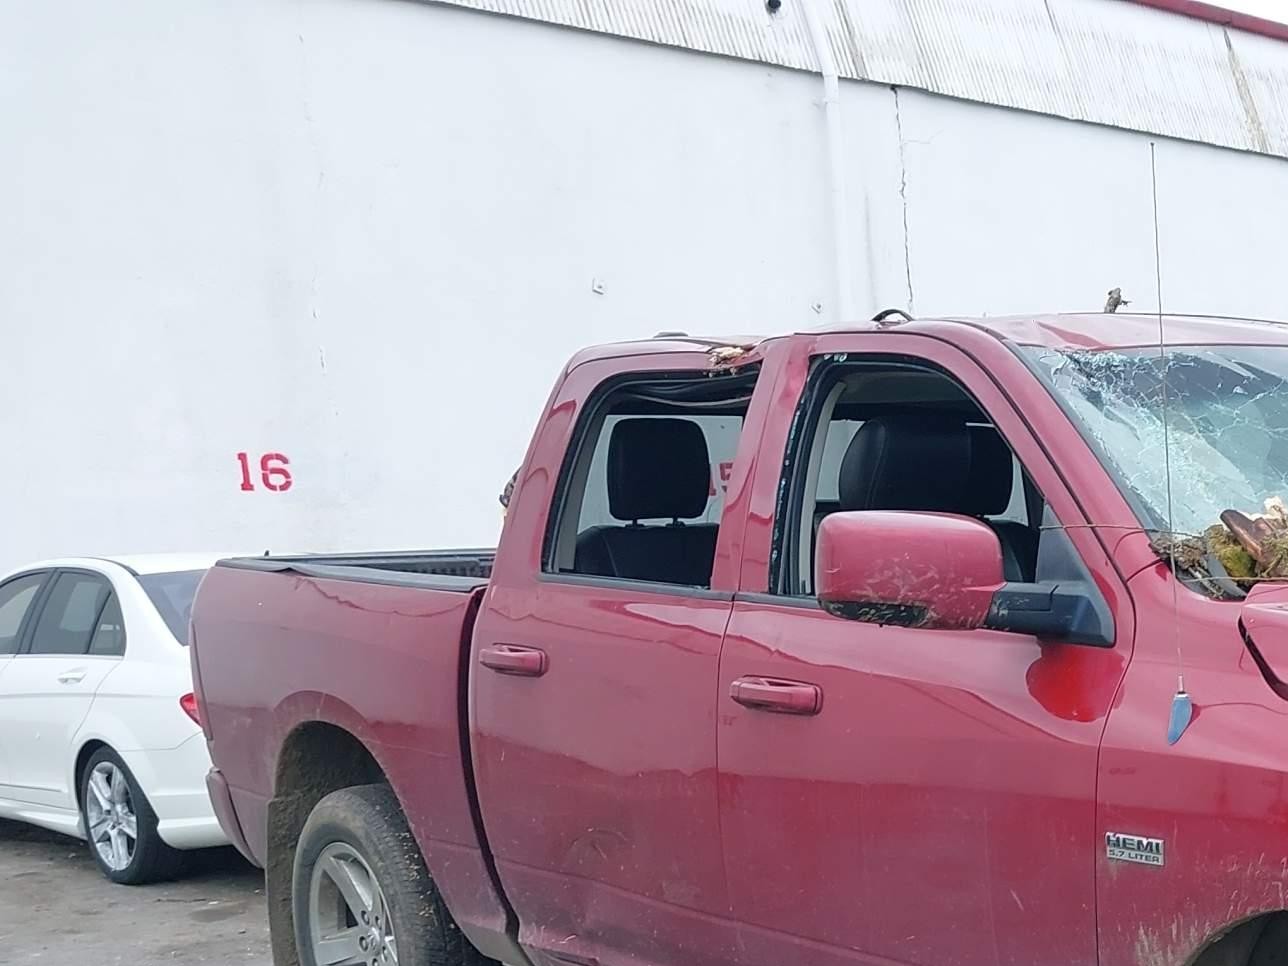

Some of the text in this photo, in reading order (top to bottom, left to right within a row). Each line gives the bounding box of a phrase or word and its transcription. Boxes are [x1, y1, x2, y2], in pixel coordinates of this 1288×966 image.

[237, 452, 292, 491] 16
[1106, 833, 1162, 854] HEMI
[1109, 849, 1160, 864] 5.7 LITER
